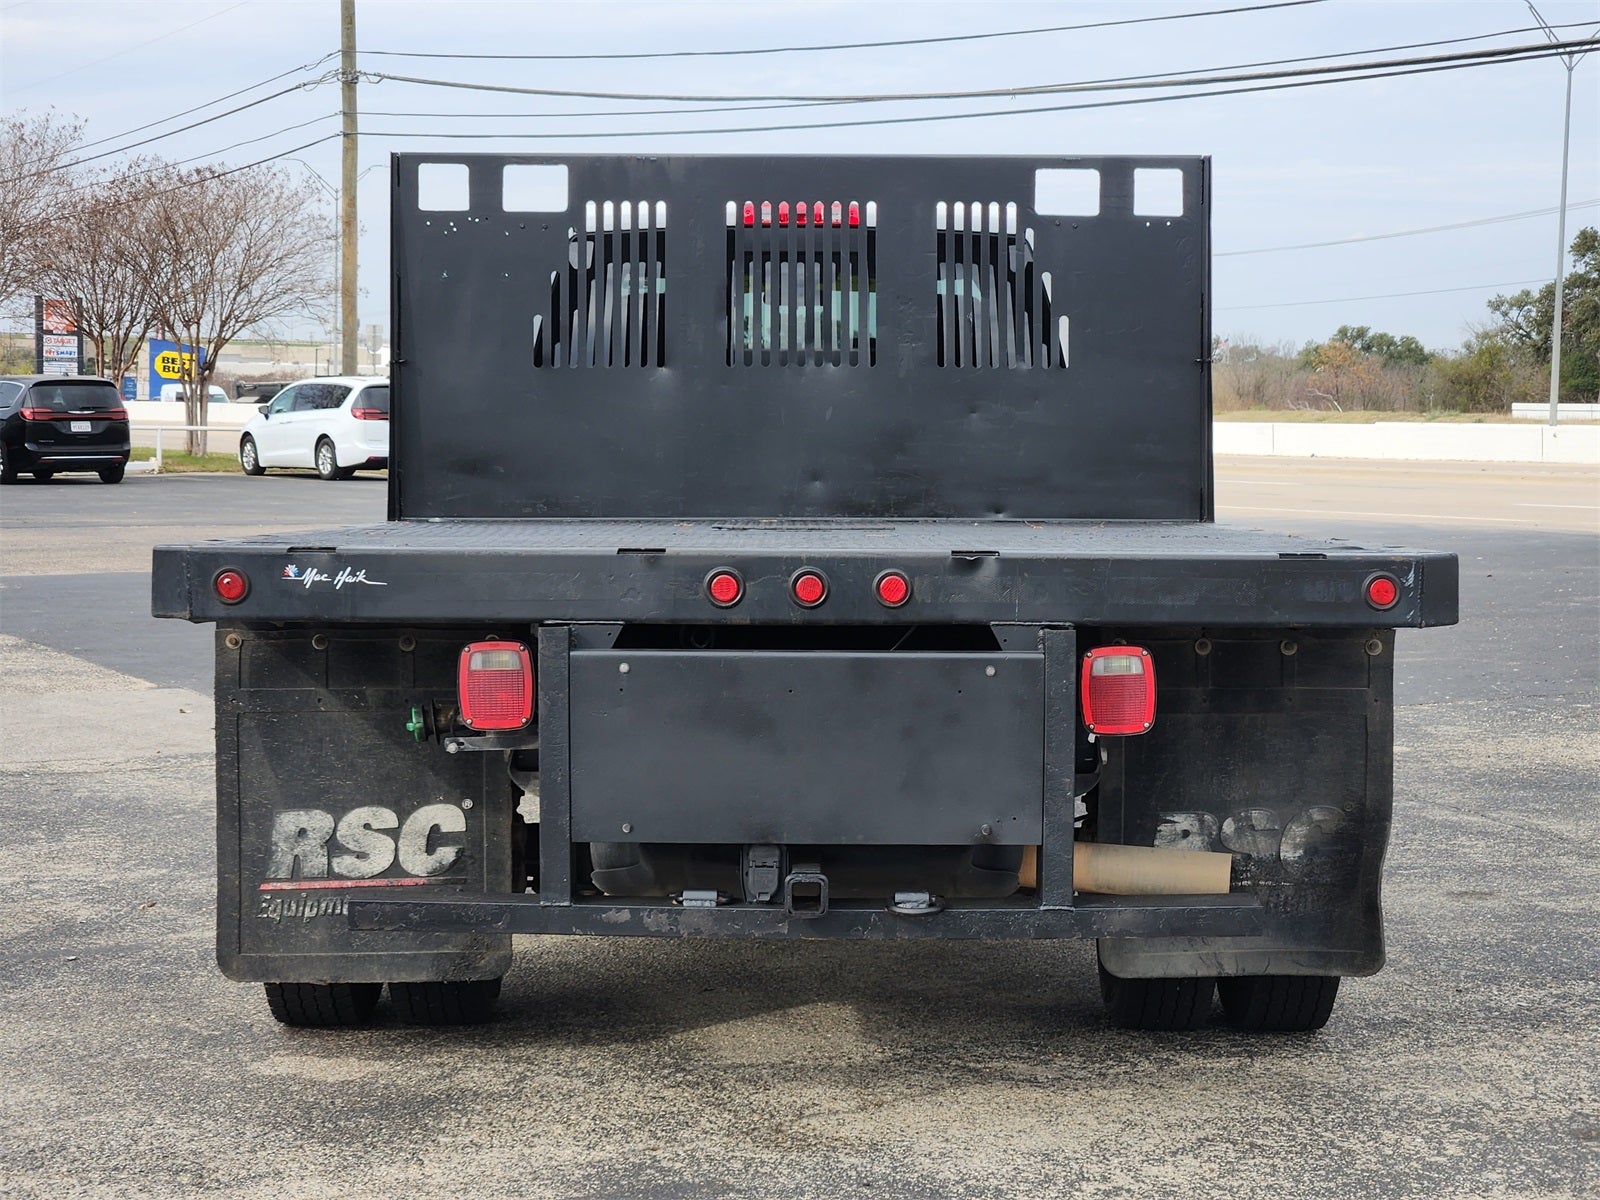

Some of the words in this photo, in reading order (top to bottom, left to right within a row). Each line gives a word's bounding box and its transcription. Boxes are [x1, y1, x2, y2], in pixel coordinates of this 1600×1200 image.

[303, 567, 332, 589] Mac
[333, 566, 388, 590] Haik
[264, 803, 467, 879] RSC
